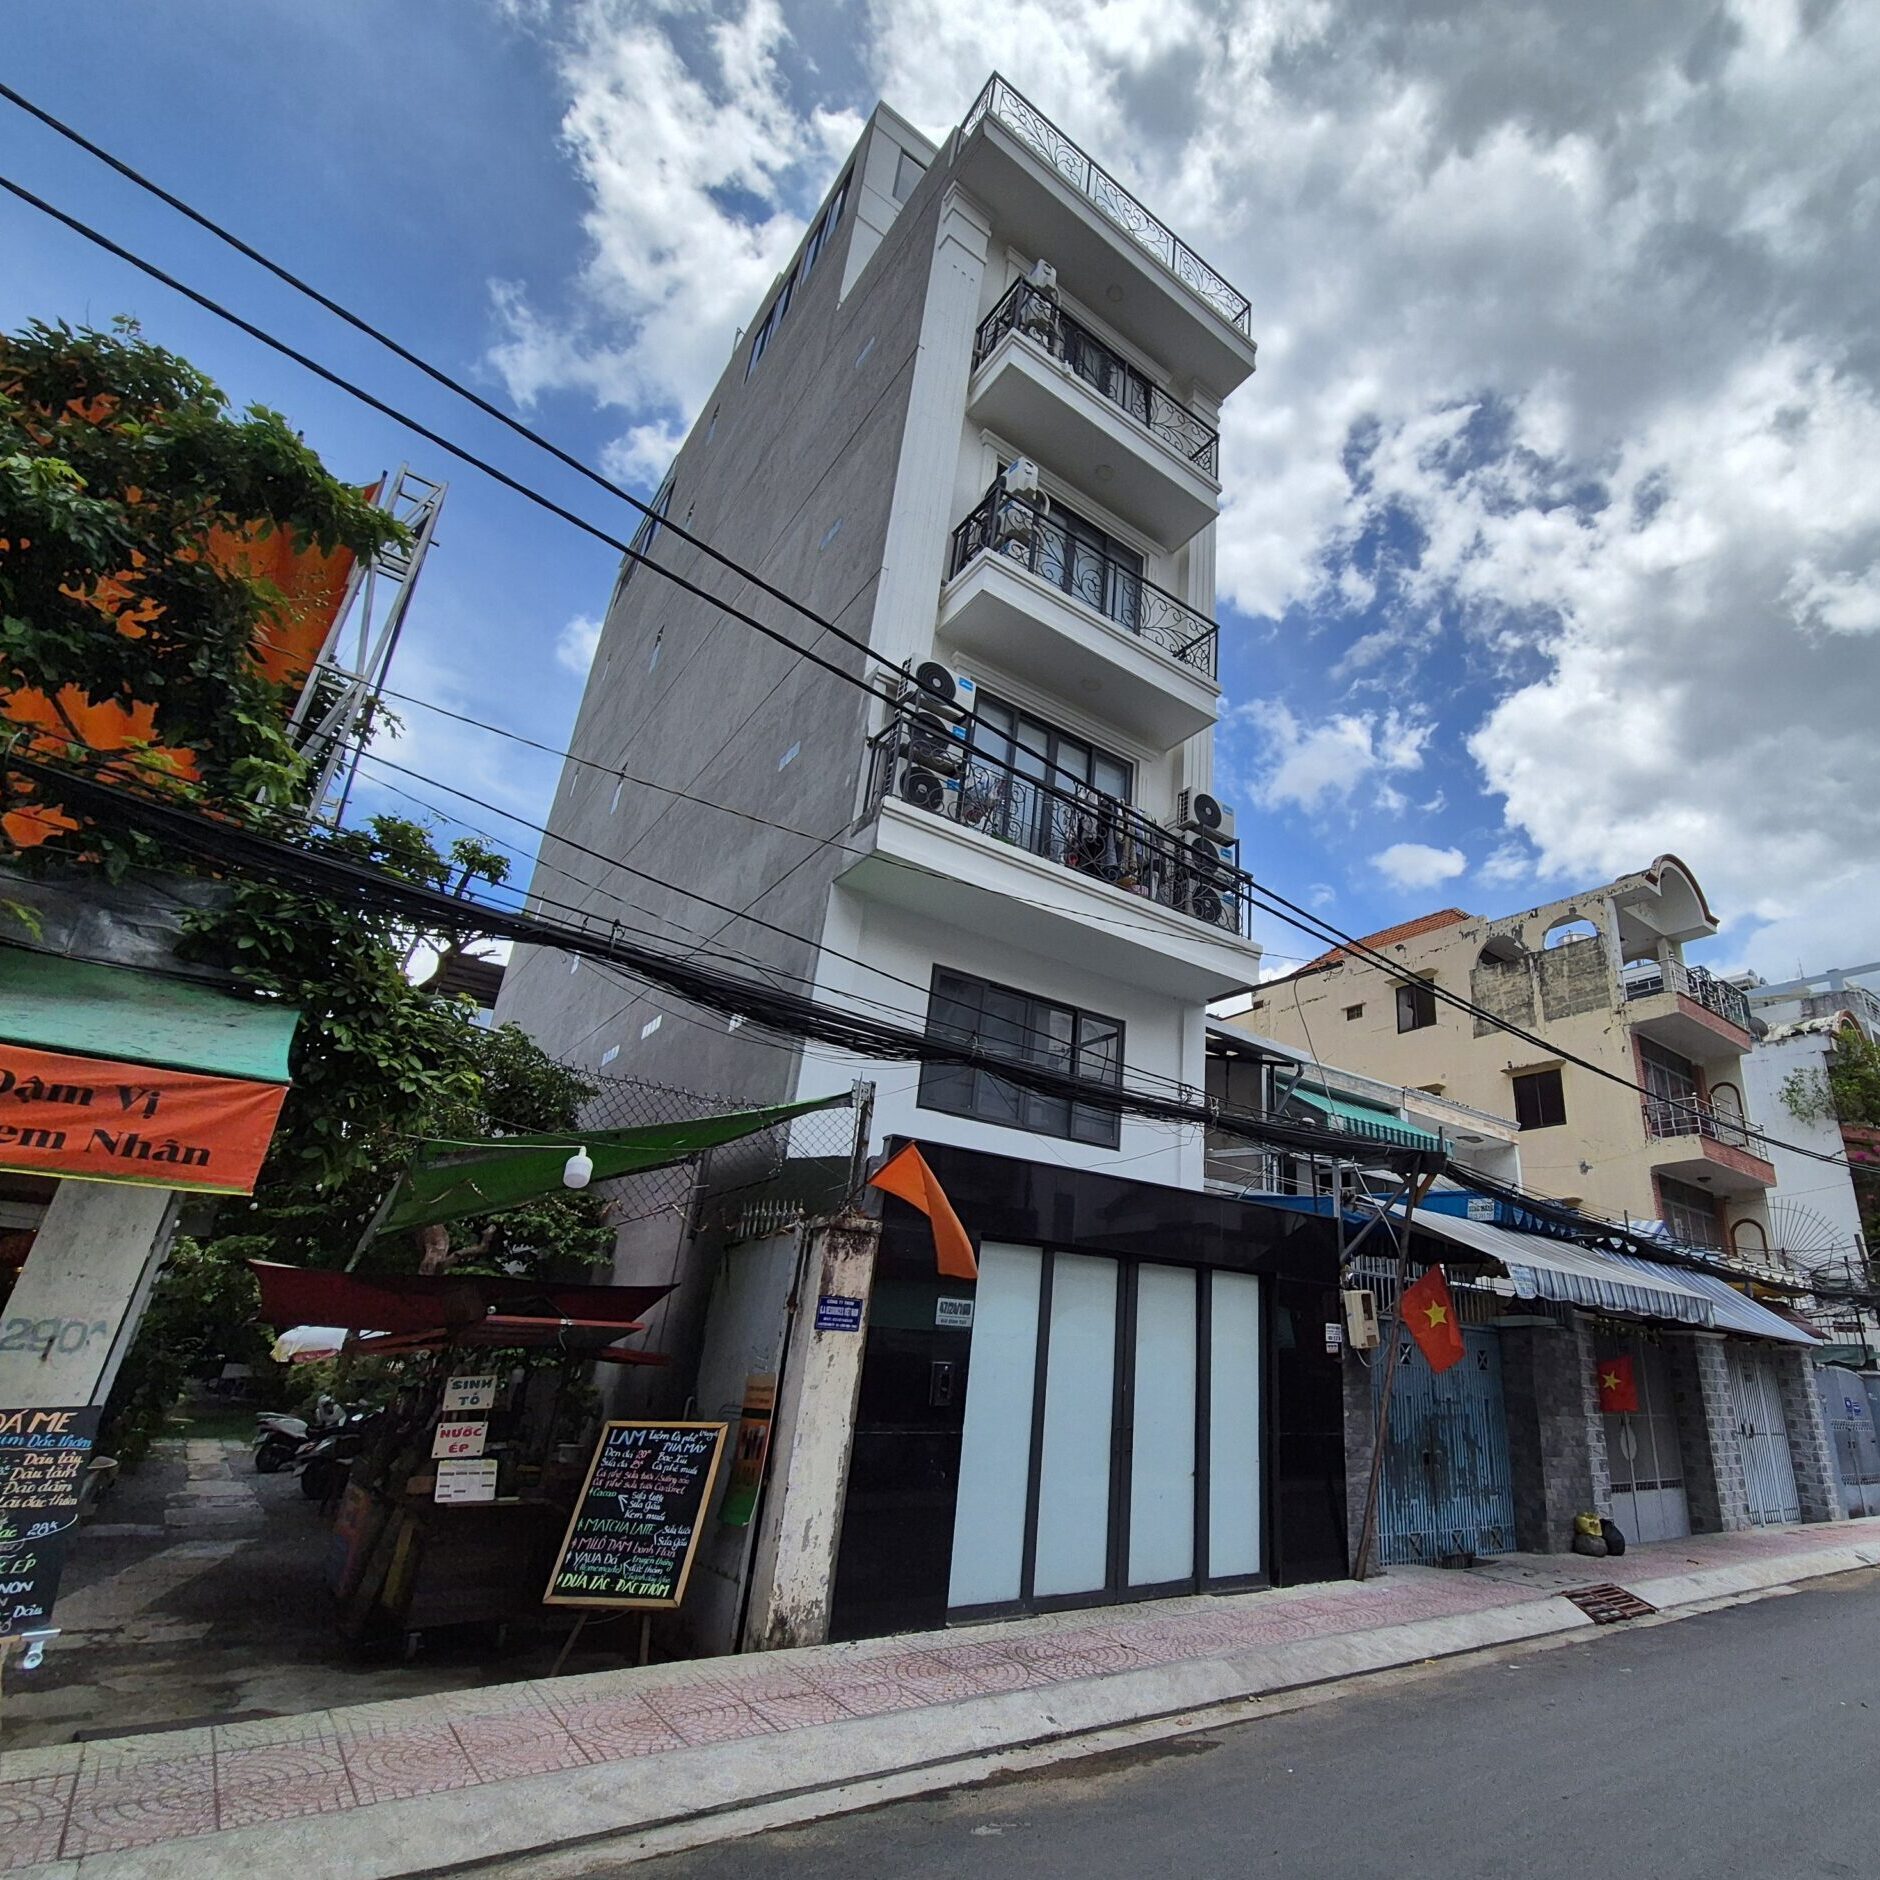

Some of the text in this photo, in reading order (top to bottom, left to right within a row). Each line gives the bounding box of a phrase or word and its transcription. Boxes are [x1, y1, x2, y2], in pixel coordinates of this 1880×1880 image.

[116, 1084, 161, 1120] Vị
[451, 1380, 493, 1390] SINH
[26, 1411, 79, 1433] ME
[448, 1441, 469, 1453] ÉP
[10, 1552, 38, 1574] ÉP
